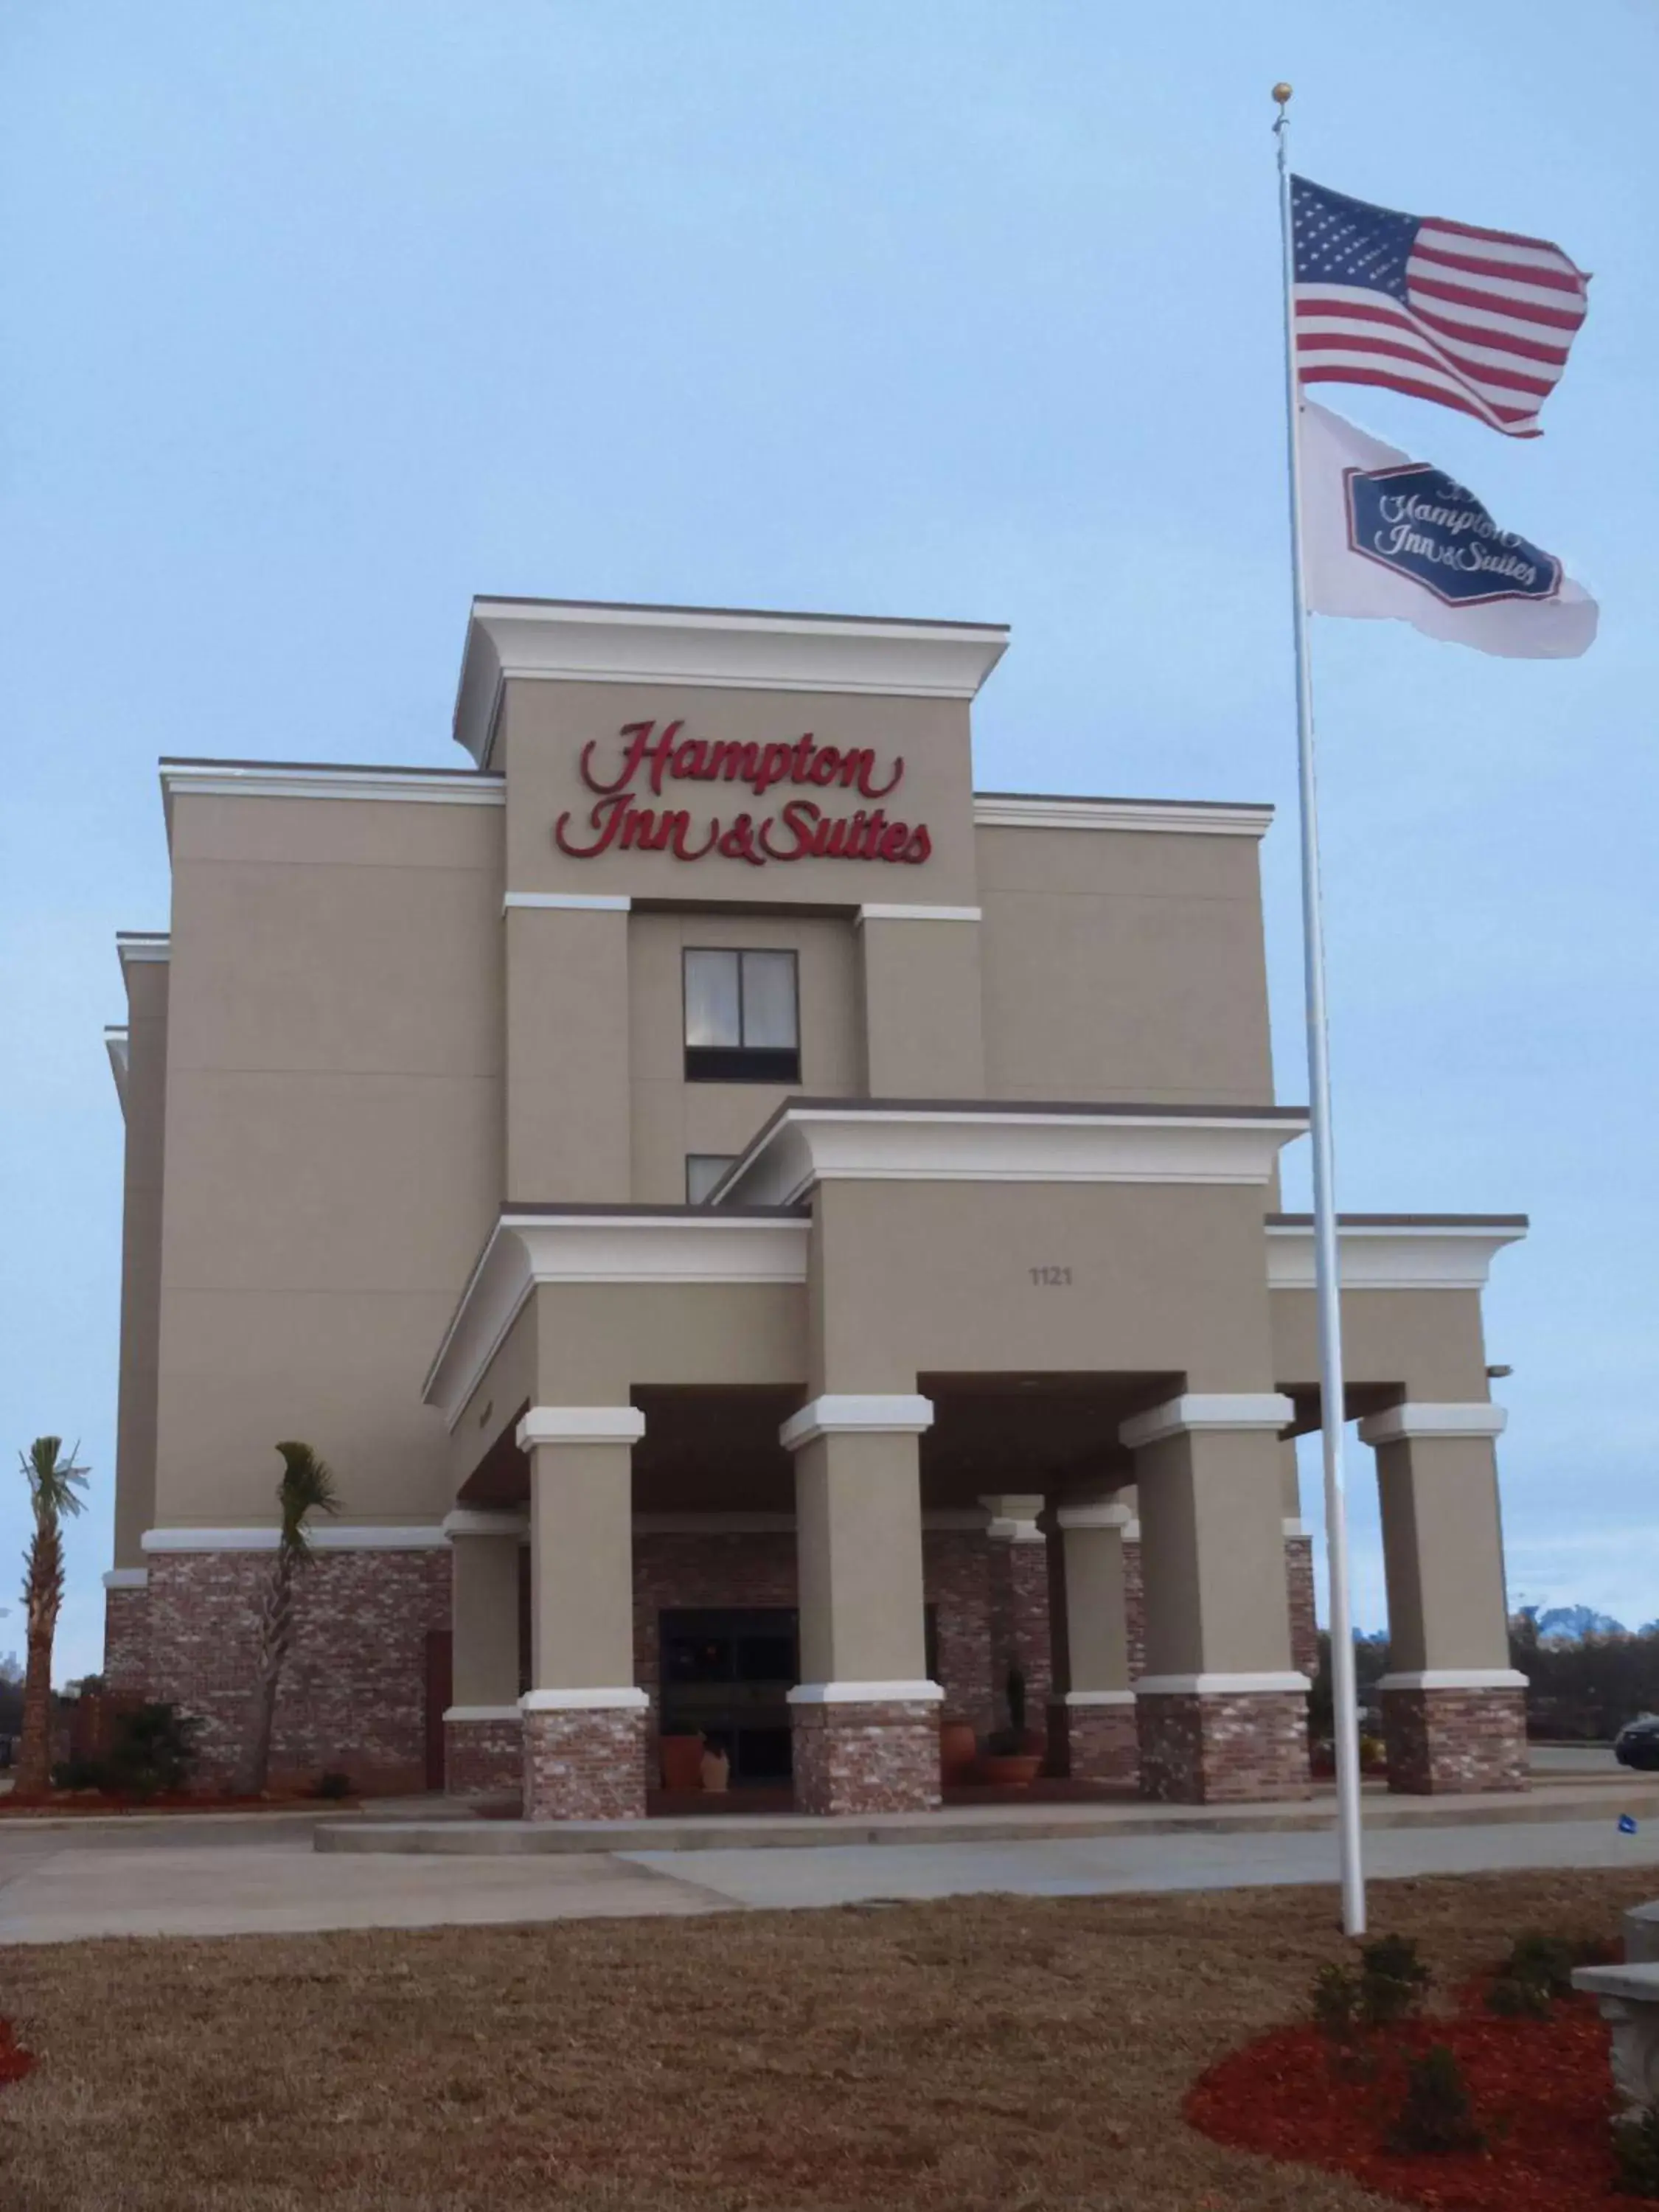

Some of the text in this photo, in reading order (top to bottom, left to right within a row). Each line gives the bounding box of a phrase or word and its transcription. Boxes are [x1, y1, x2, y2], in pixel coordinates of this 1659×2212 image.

[1374, 524, 1443, 563] Inn
[1456, 541, 1537, 585] Suites
[580, 720, 904, 799] Hampton
[555, 793, 933, 866] Inn & Suites
[1028, 1265, 1073, 1287] 1121
